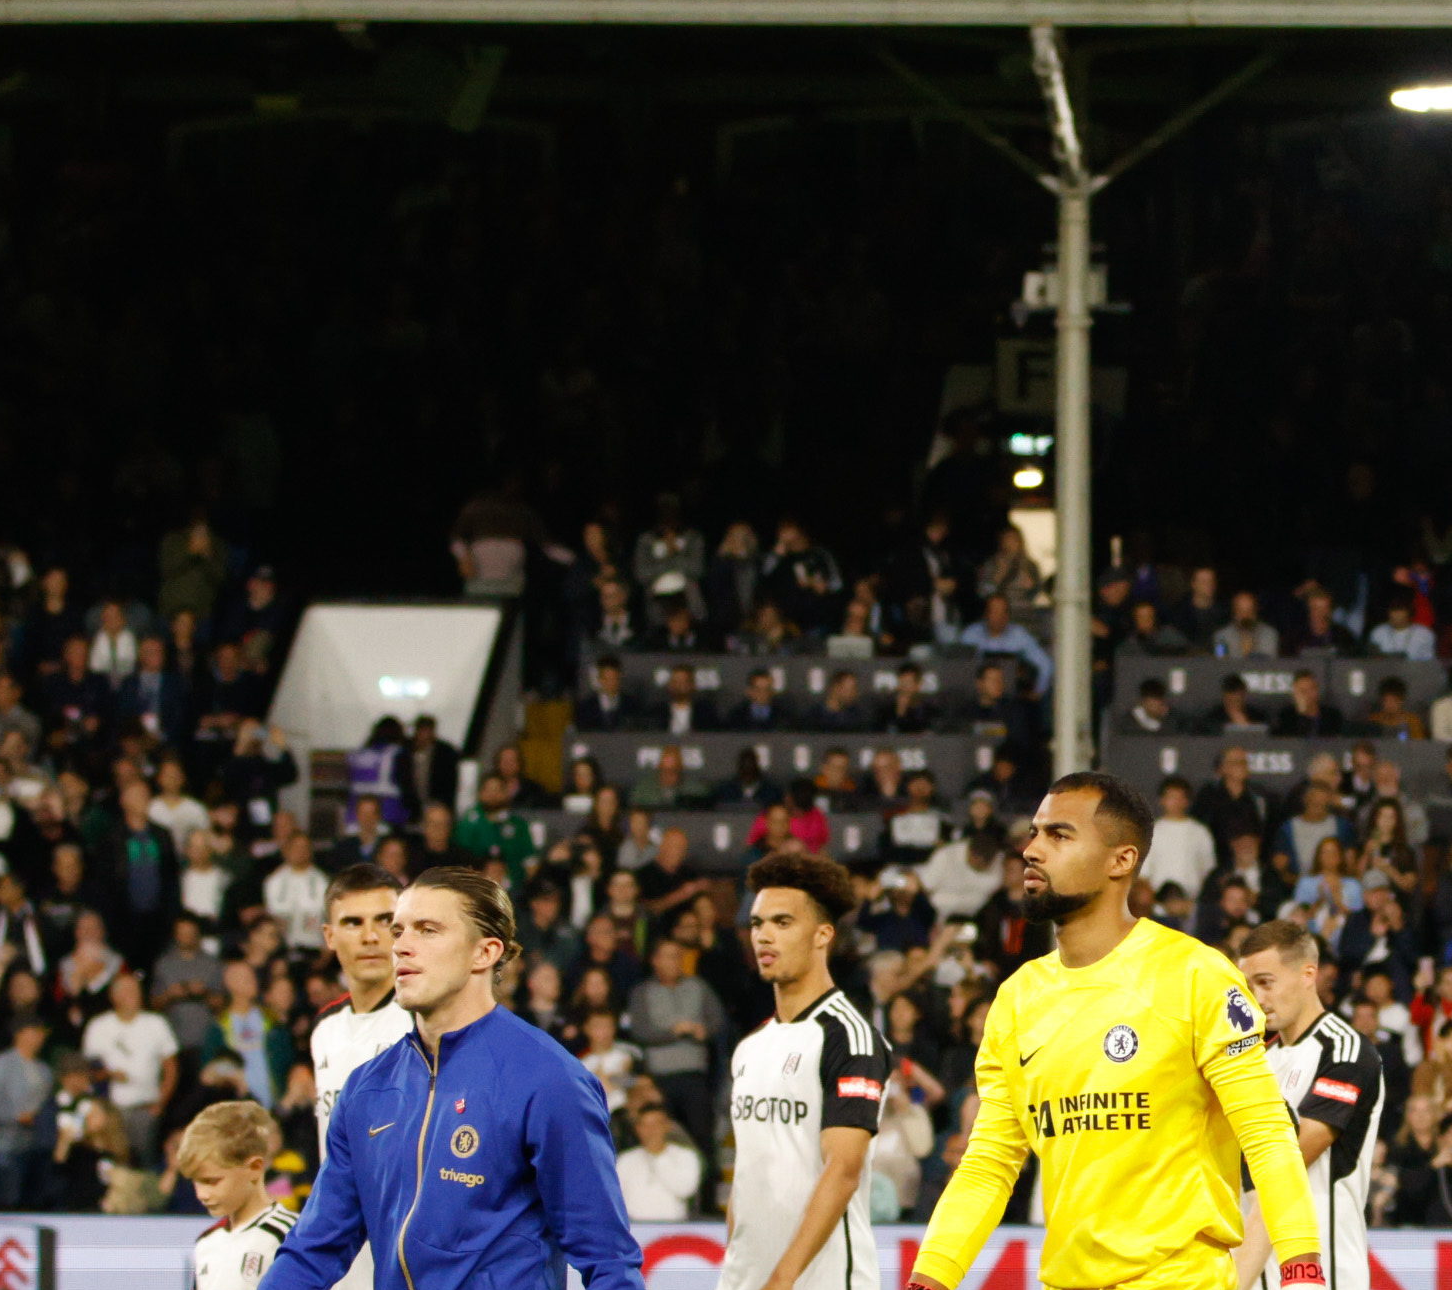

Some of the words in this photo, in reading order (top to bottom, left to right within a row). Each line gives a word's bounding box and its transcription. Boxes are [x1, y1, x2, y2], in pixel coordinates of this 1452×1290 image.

[1018, 351, 1055, 402] F
[1059, 1091, 1150, 1114] INFINITE
[1062, 1112, 1152, 1136] ATHLETE
[439, 1168, 485, 1188] trivago
